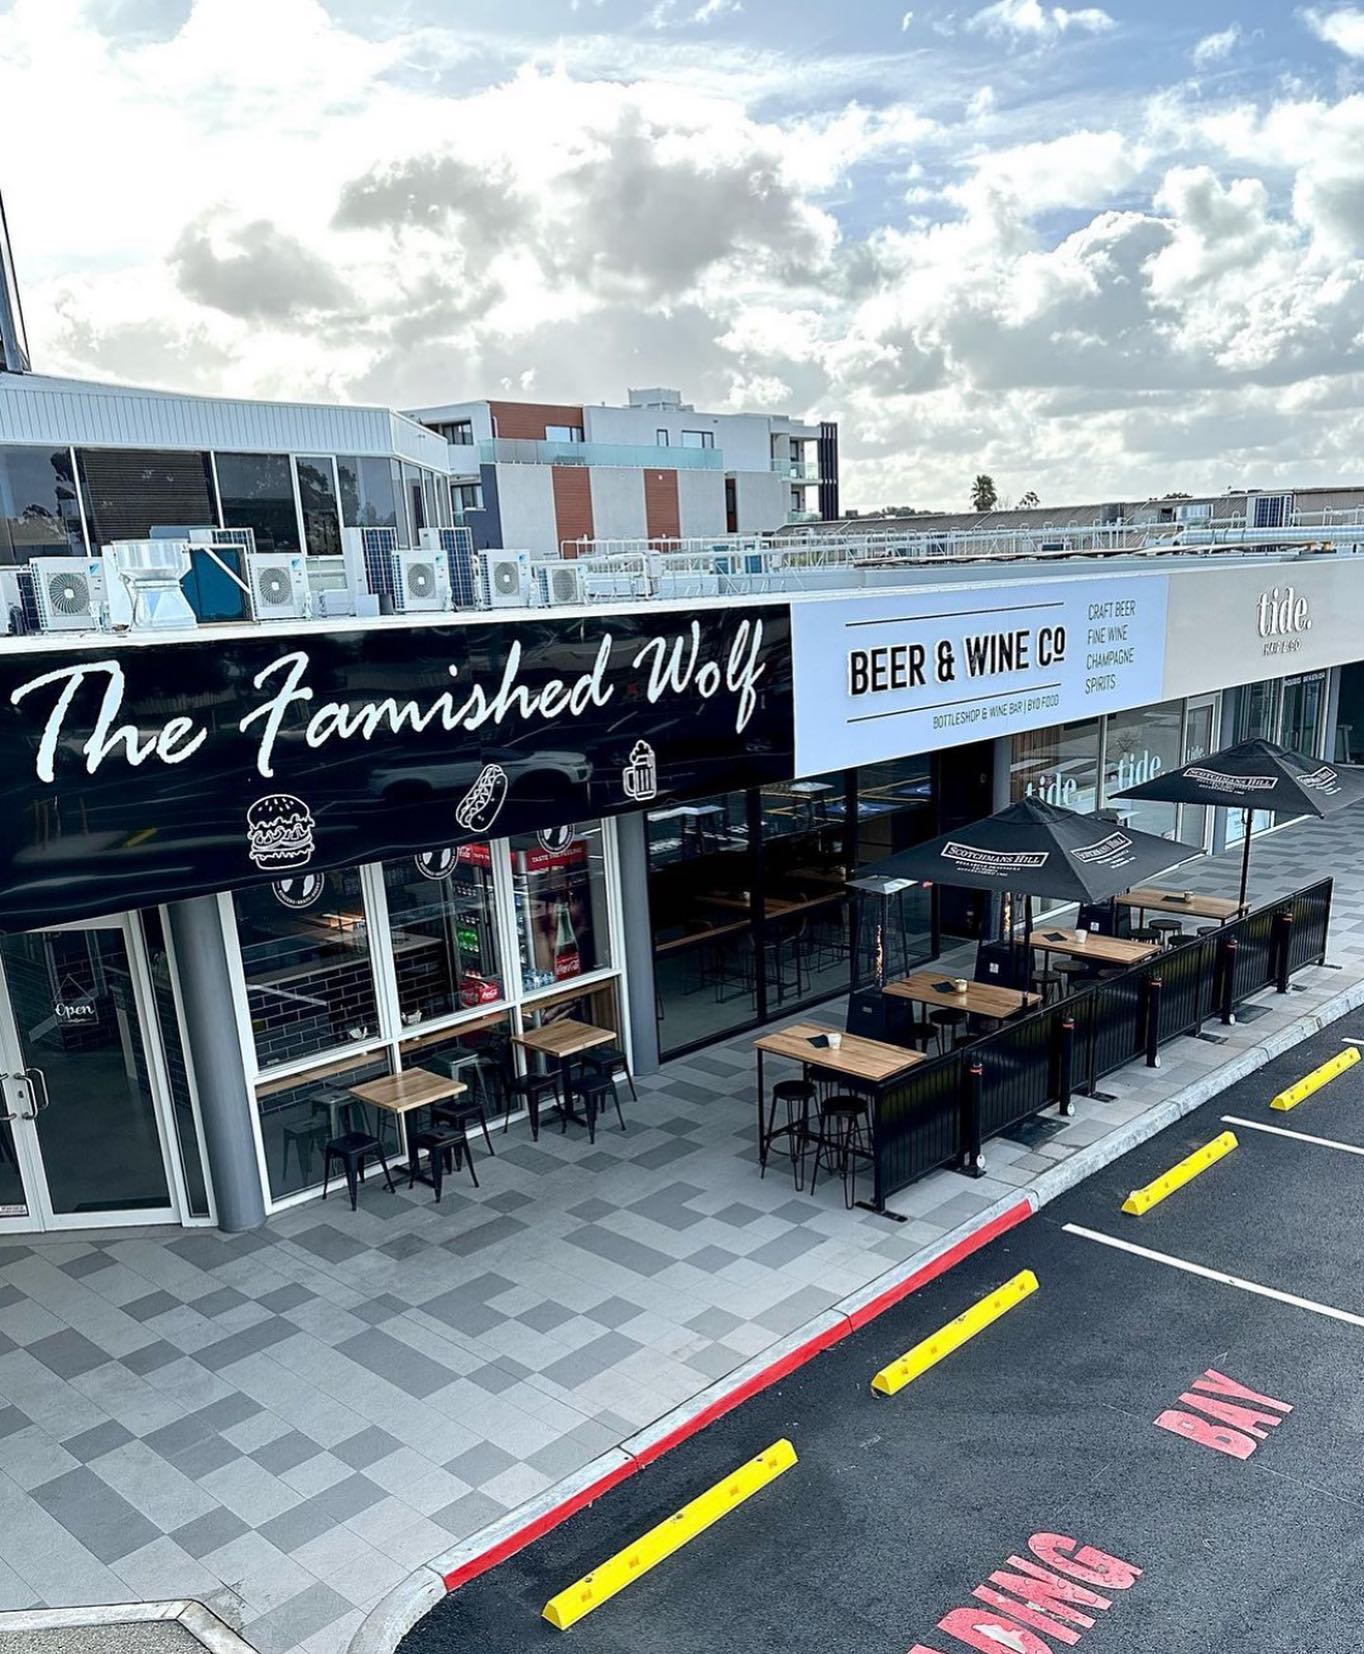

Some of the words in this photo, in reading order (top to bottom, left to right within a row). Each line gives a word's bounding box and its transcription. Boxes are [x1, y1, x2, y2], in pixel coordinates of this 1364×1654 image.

[1088, 602, 1114, 620] CRAFT
[1115, 600, 1136, 617] BEER
[1257, 587, 1312, 637] tide.
[1088, 627, 1106, 645] FINE
[1108, 624, 1128, 641] WINE
[850, 644, 927, 696] BEER
[937, 640, 955, 683] &
[965, 629, 1030, 678] WINE
[1086, 647, 1135, 670] CHAMPAGNE
[1085, 674, 1116, 694] SPIRITS
[10, 659, 207, 783] The
[239, 634, 614, 778] Famished
[632, 618, 766, 734] Wolf
[933, 708, 981, 729] BOTTLESHOP
[982, 707, 988, 720] &
[990, 704, 1008, 718] WINE
[1009, 701, 1022, 715] BAR
[1027, 697, 1041, 712] BYO
[1042, 694, 1060, 708] FOOD
[948, 846, 1014, 863] SCOTCHMANS
[1013, 855, 1041, 864] HILL
[55, 1002, 95, 1019] Open
[907, 1531, 1145, 1654] DING
[1152, 1368, 1294, 1460] BAY
